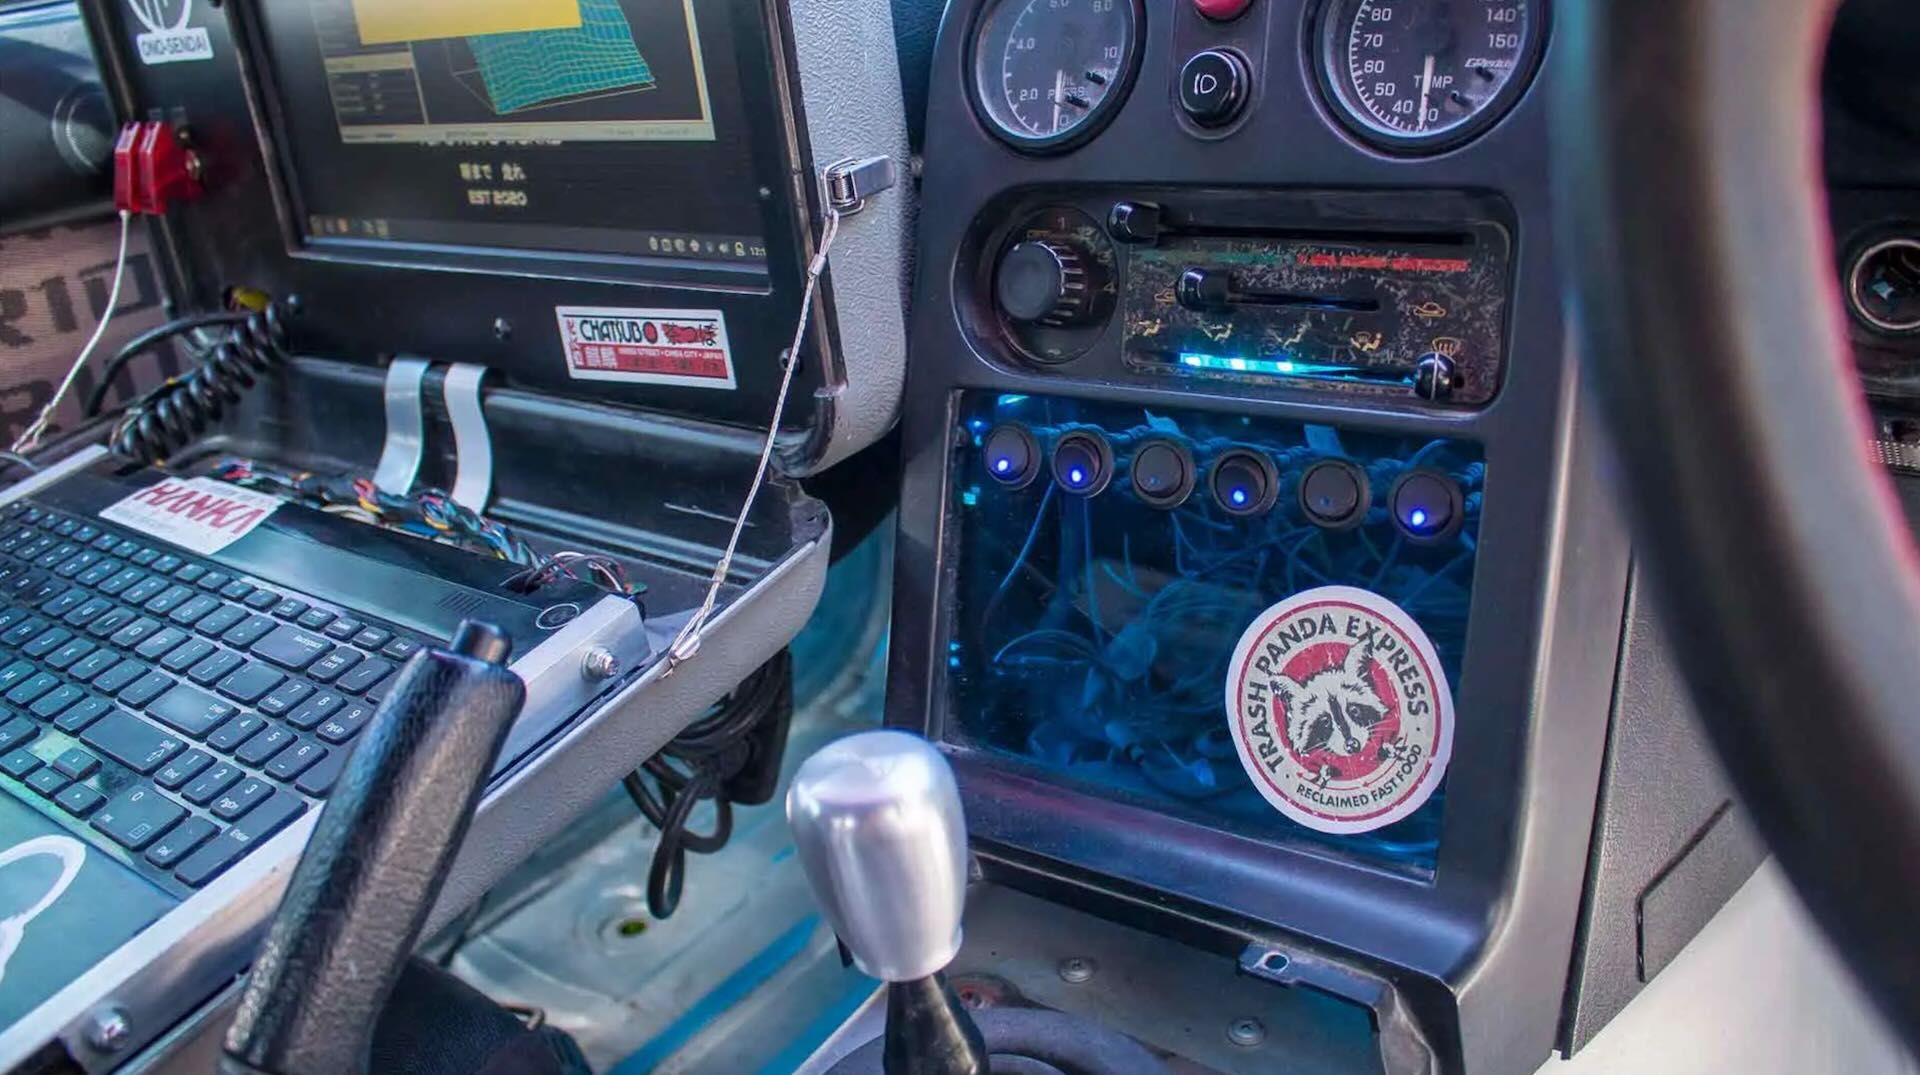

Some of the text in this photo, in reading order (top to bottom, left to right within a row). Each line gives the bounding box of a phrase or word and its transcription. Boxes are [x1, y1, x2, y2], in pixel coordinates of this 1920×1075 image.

[1371, 8, 1392, 21] 80
[1487, 8, 1516, 22] 140
[1016, 38, 1036, 49] 4.0
[1364, 34, 1384, 47] 70
[1488, 34, 1518, 48] 150
[1104, 46, 1118, 59] 10
[1364, 60, 1385, 73] 60
[1414, 75, 1453, 88] TMP
[1019, 88, 1038, 101] 2.0
[1374, 83, 1396, 96] 50
[1392, 100, 1413, 113] 40
[1247, 613, 1428, 774] TRASH PANDA EXPRESS
[1296, 743, 1422, 808] RECLAIMED FAST FOOD
